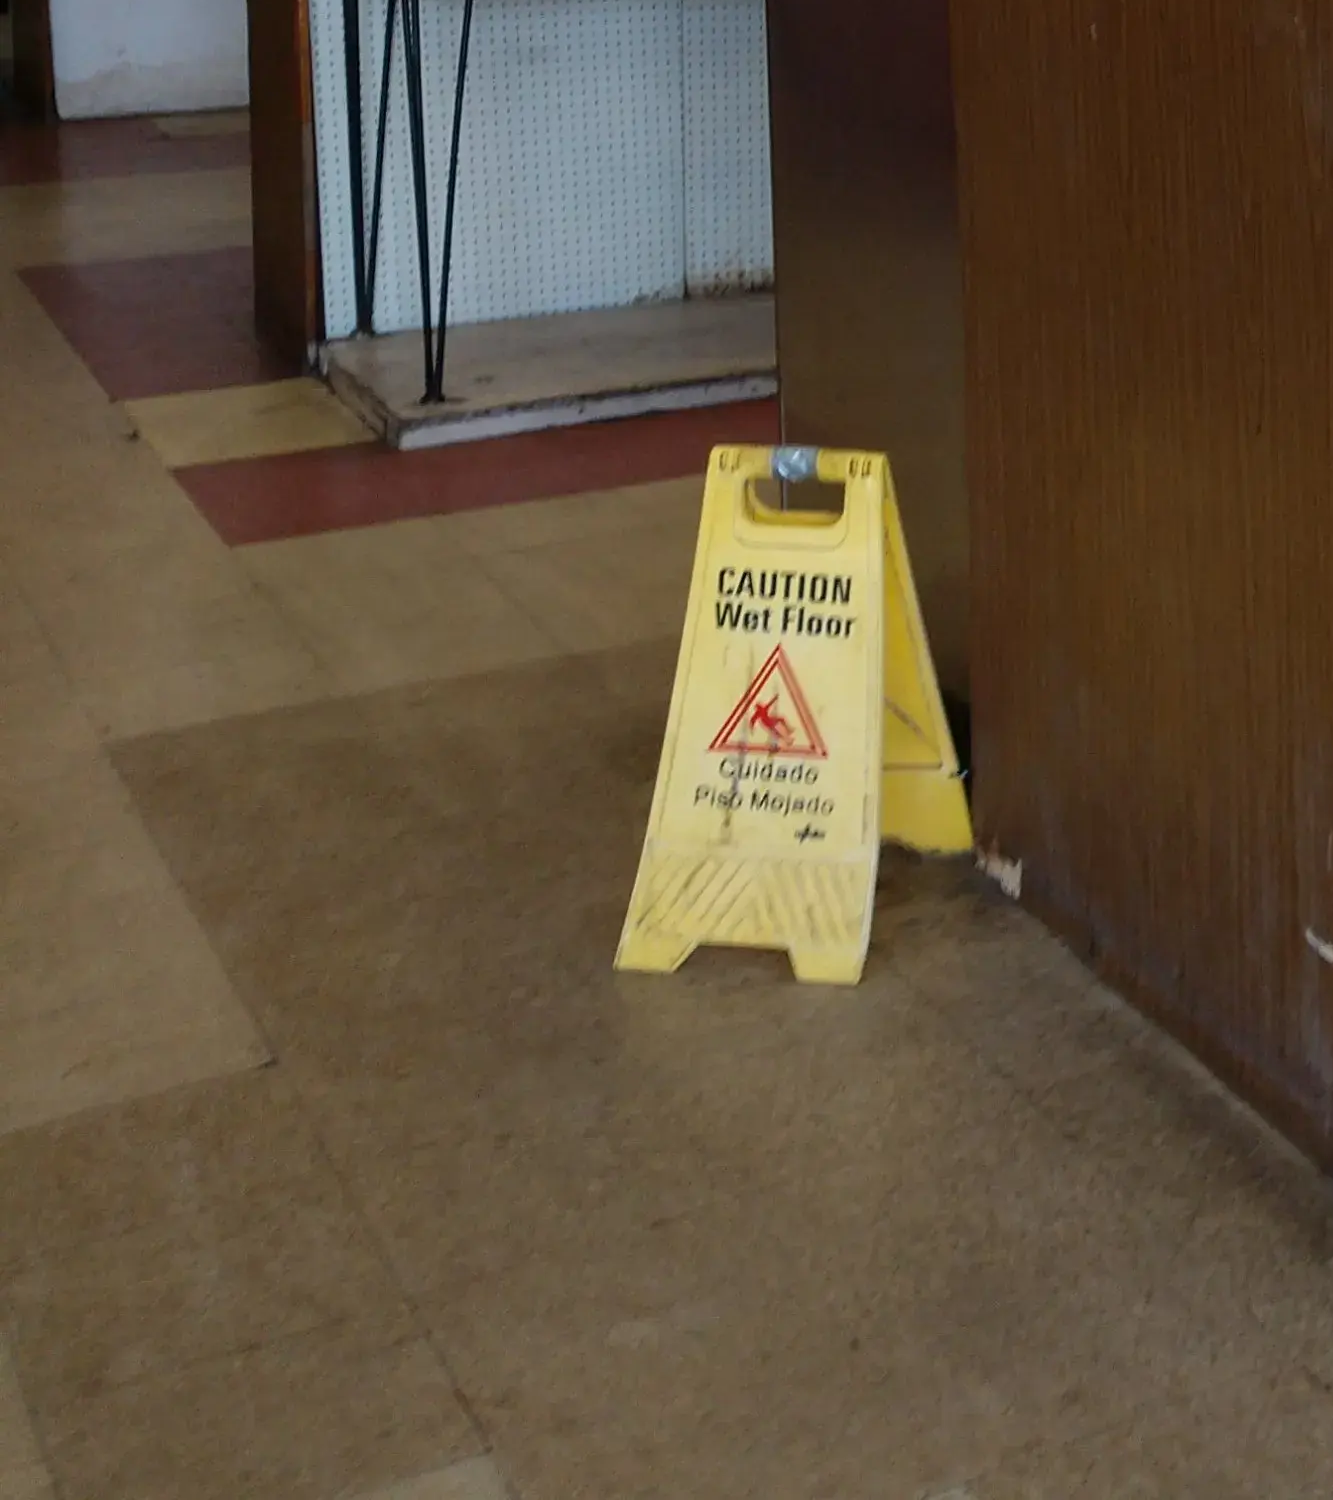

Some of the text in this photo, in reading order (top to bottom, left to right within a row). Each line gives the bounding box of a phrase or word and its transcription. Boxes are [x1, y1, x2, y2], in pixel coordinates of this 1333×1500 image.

[717, 566, 852, 605] CAUTION
[715, 600, 858, 640] Wet Floor
[718, 756, 820, 786] Cuidado
[692, 783, 836, 818] Piso Mojado
